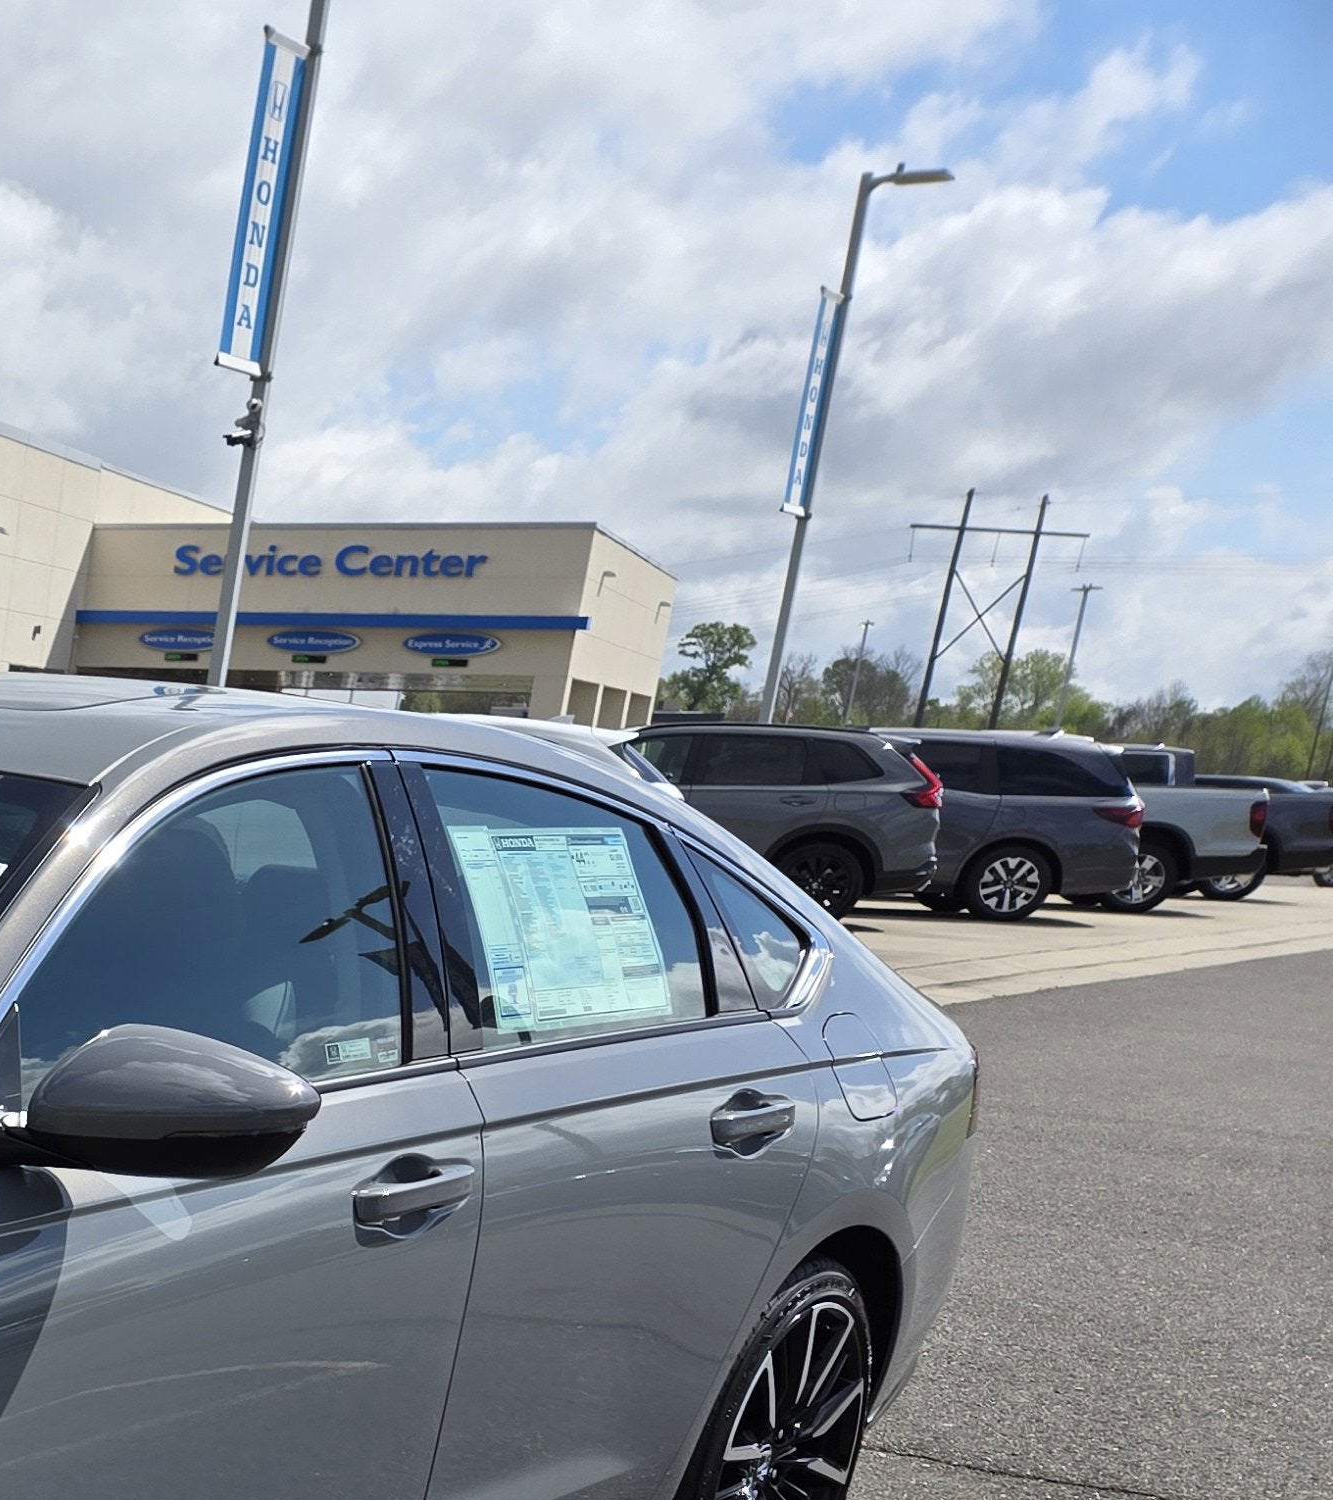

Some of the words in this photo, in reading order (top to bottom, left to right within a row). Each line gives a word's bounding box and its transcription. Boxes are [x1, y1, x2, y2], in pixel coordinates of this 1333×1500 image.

[236, 136, 280, 330] HONDA
[793, 357, 824, 486] HONDA
[174, 544, 322, 577] Sevice
[335, 544, 487, 578] Center
[144, 634, 176, 643] Service
[177, 635, 215, 646] Receptio
[273, 635, 306, 645] Service
[307, 636, 353, 647] Reception
[407, 639, 443, 650] Express
[445, 640, 479, 649] Service
[500, 837, 535, 848] HONDA
